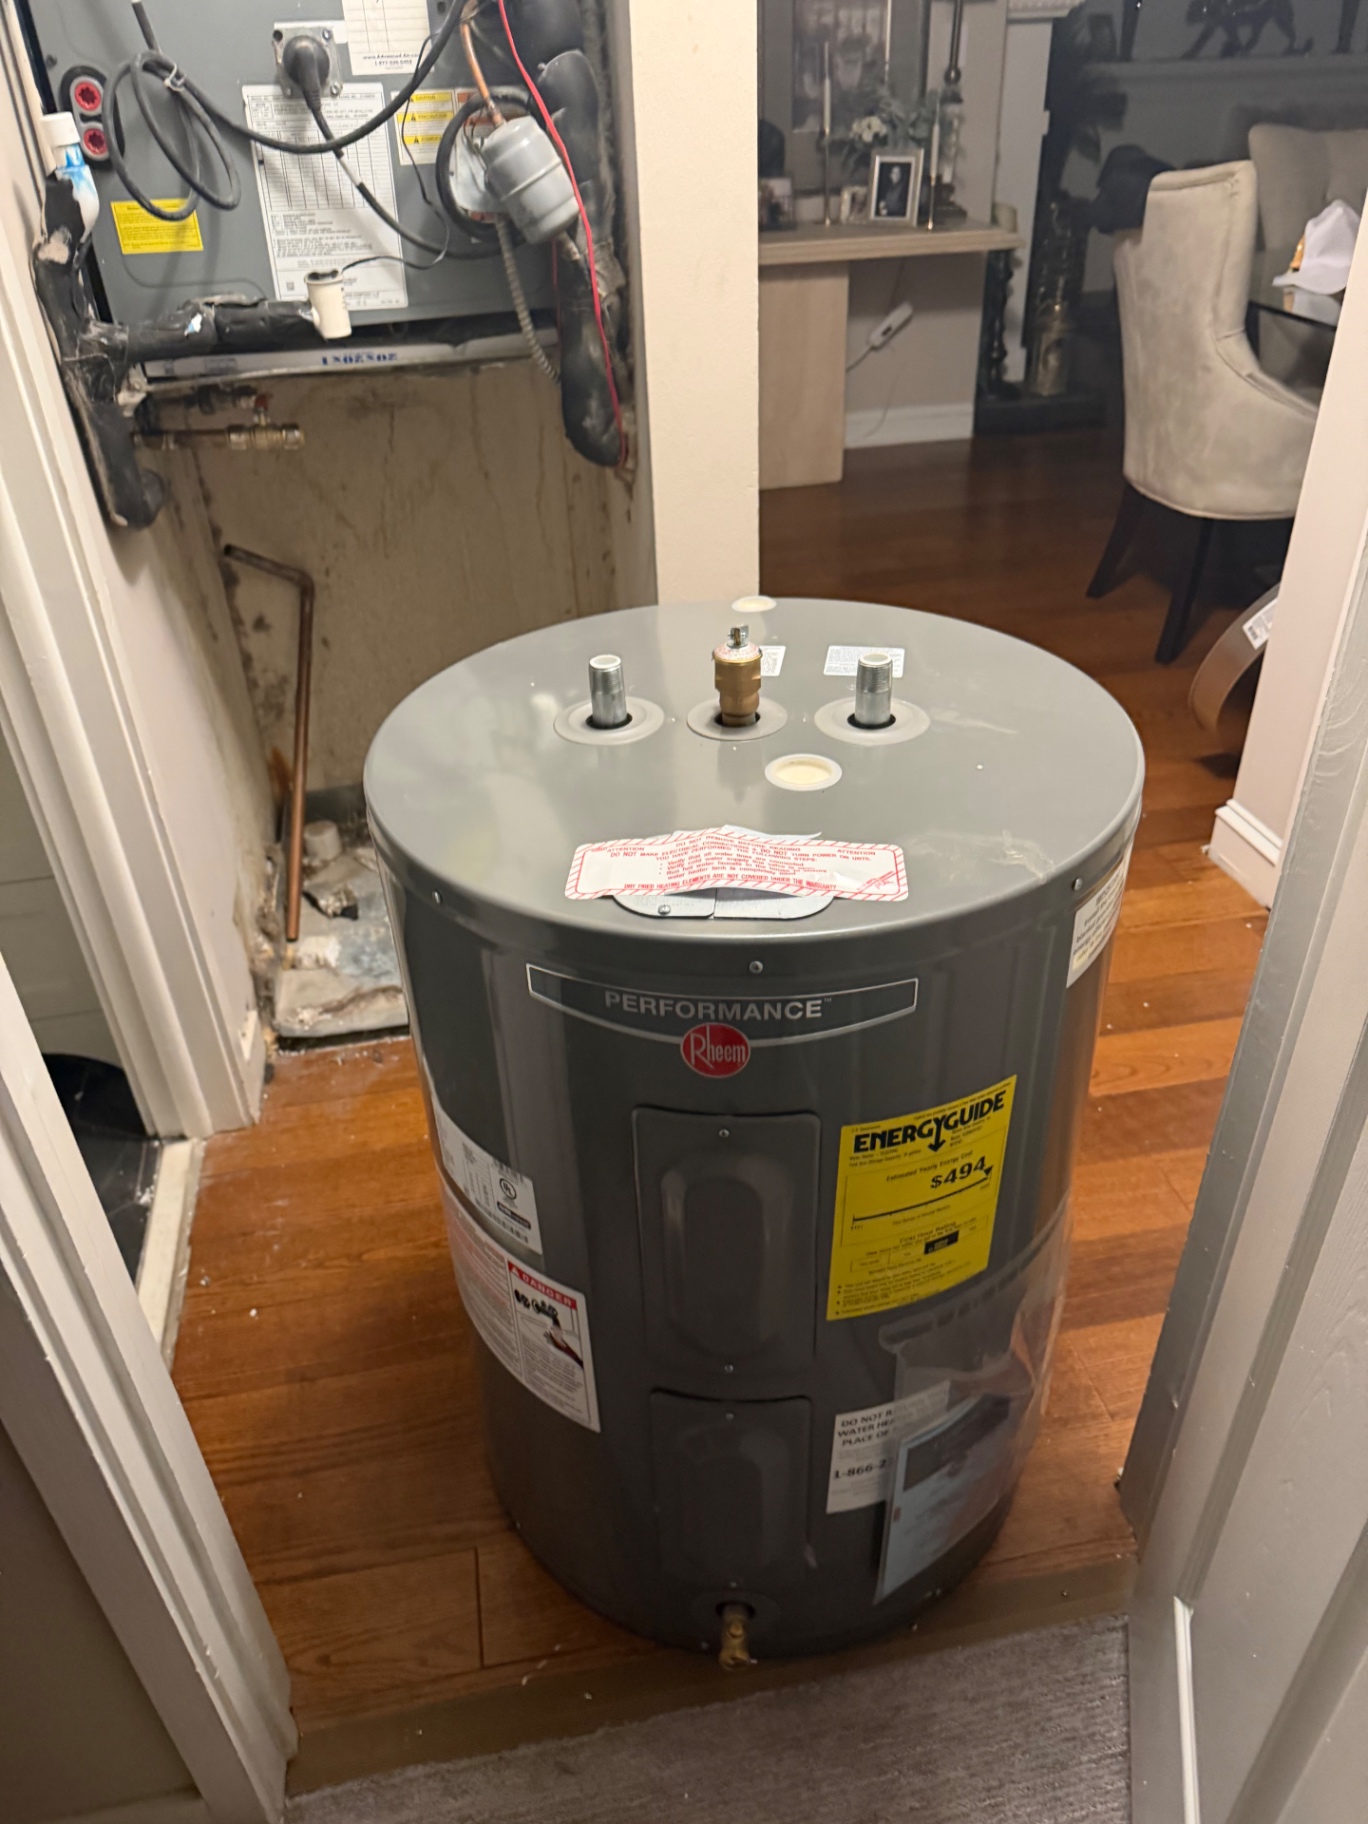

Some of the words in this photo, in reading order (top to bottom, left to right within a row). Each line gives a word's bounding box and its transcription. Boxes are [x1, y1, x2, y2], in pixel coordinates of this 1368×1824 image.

[657, 881, 680, 889] HEATING
[682, 873, 711, 885] ELEMENTS
[805, 880, 837, 890] WARRANTY
[604, 990, 823, 1021] PERFORMANCE
[689, 1025, 747, 1069] Rheem
[853, 1089, 1006, 1154] ENERGYGUIDE
[930, 1156, 986, 1189] $494
[522, 1274, 573, 1308] DANGER
[837, 1423, 875, 1438] WATER
[841, 1418, 858, 1427] DO
[861, 1411, 882, 1423] NOT
[841, 1433, 873, 1446] PLACE
[876, 1429, 889, 1439] OF
